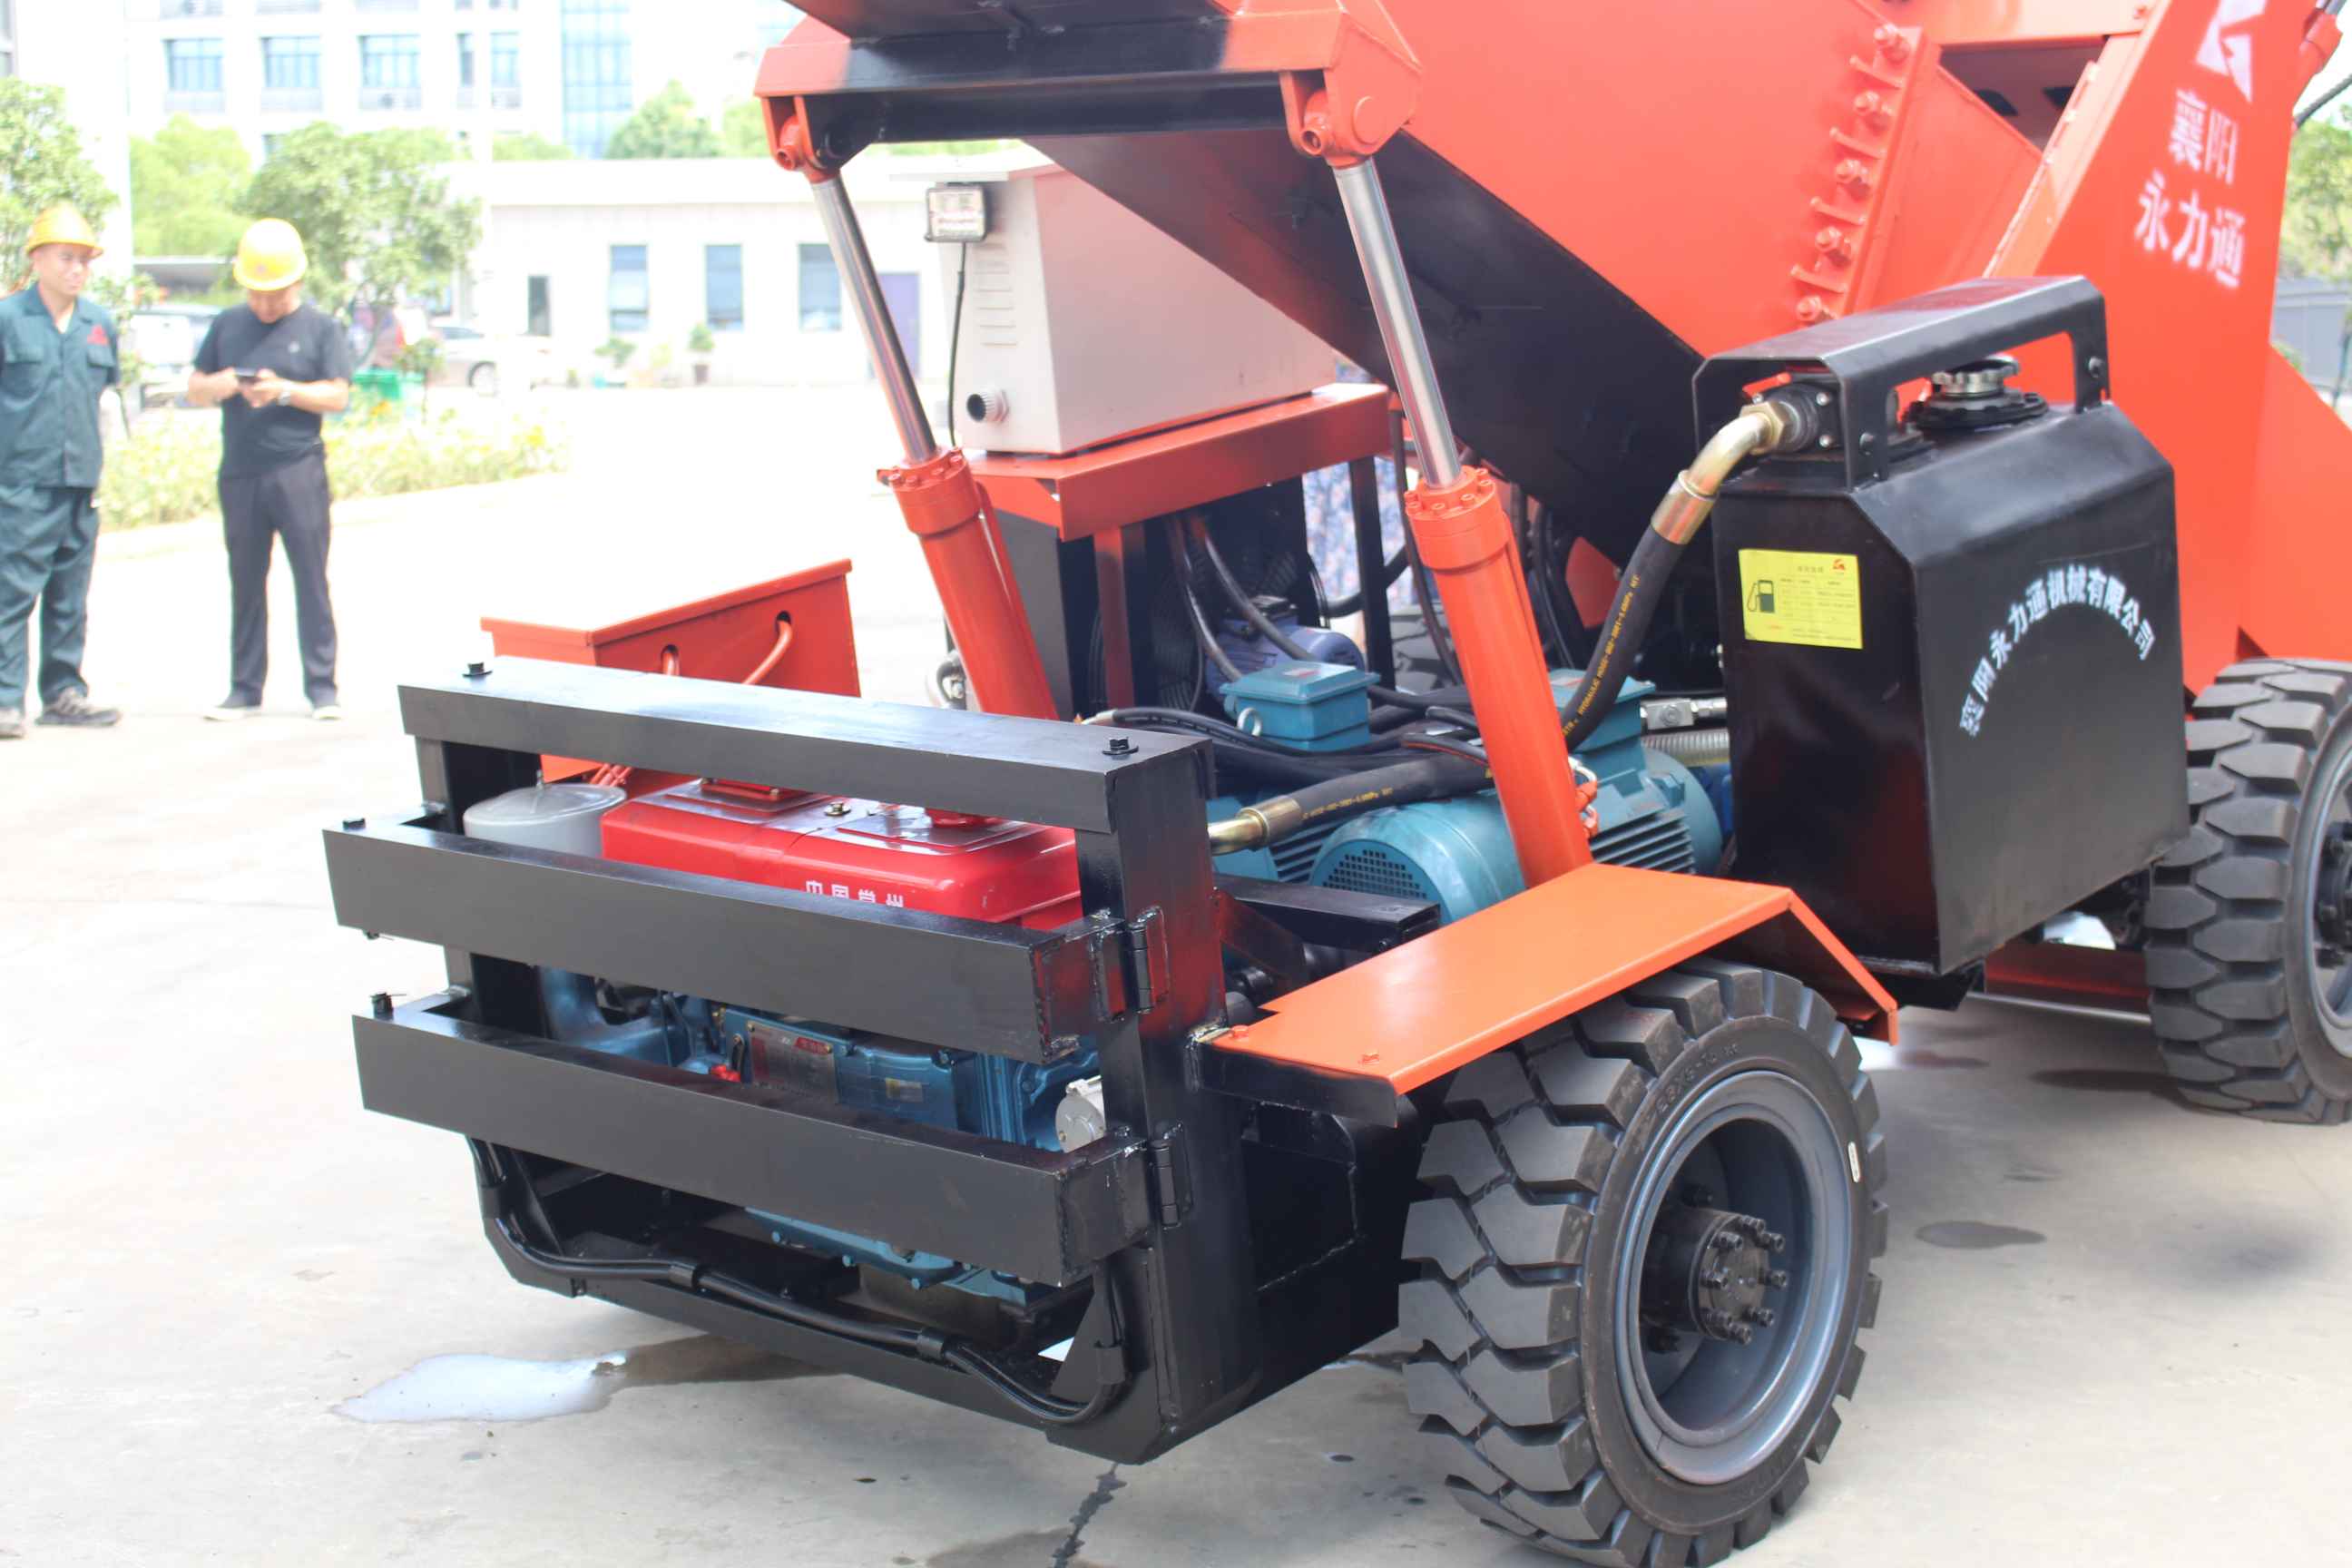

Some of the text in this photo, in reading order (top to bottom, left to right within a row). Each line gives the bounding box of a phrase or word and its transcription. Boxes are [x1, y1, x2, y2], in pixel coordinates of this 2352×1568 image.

[2169, 87, 2239, 186] 襄阳
[2134, 168, 2247, 289] 永力通
